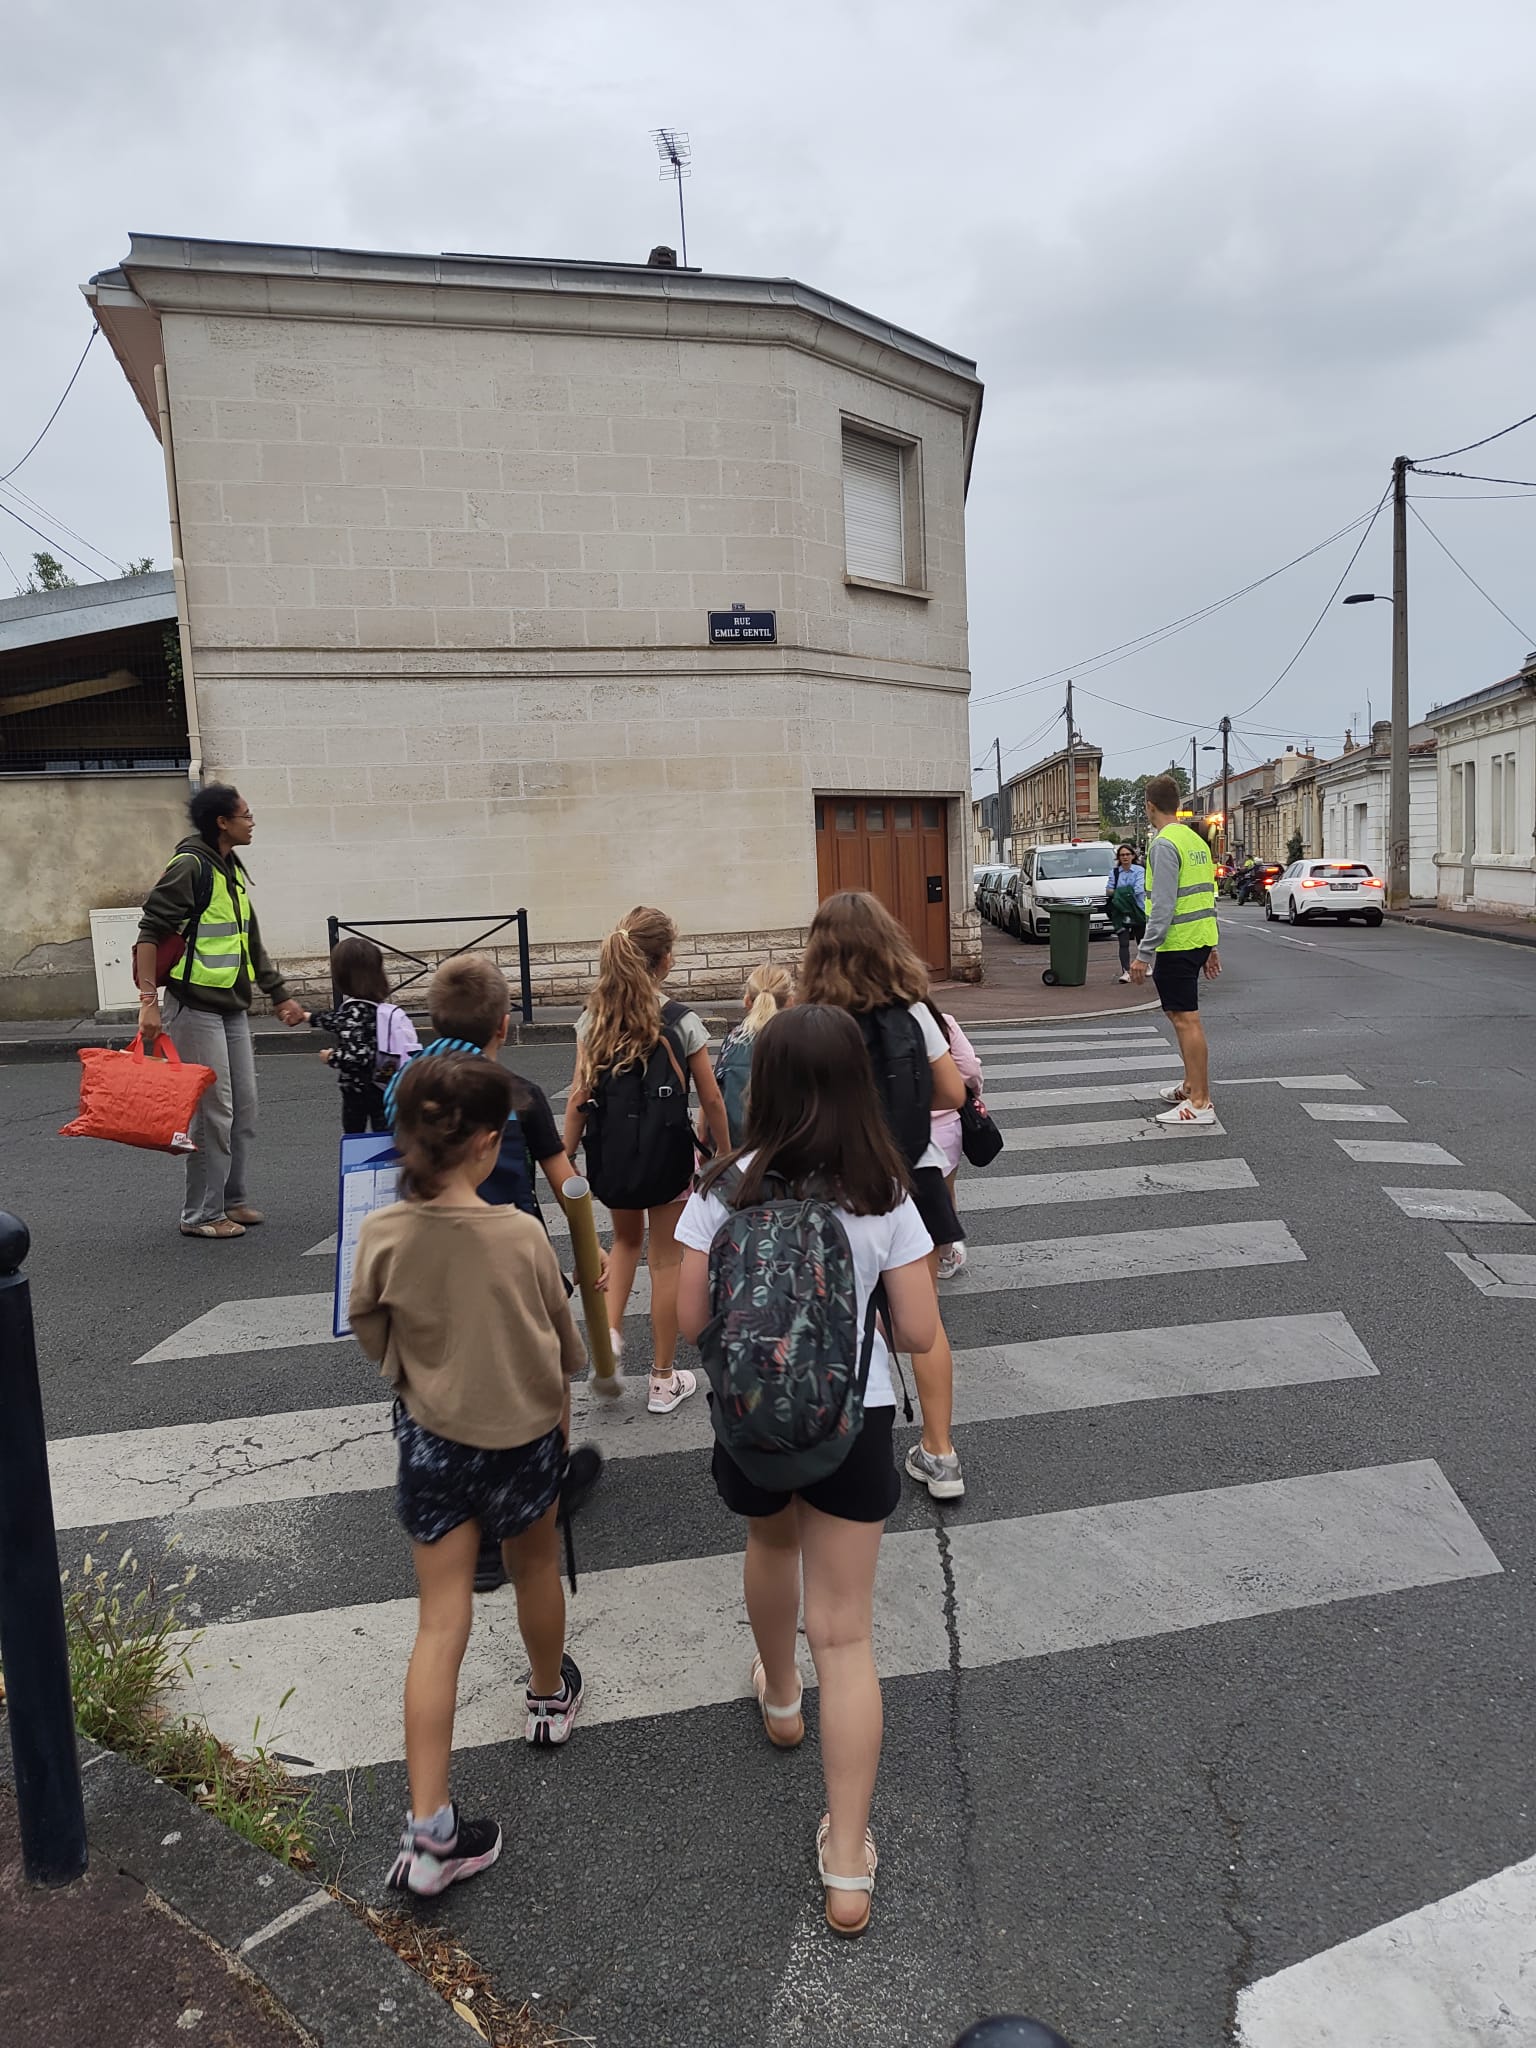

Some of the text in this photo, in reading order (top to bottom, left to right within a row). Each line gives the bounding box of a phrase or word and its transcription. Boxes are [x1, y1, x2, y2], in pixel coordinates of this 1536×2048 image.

[733, 617, 751, 625] RUE
[715, 628, 771, 637] EMILE GENTIL
